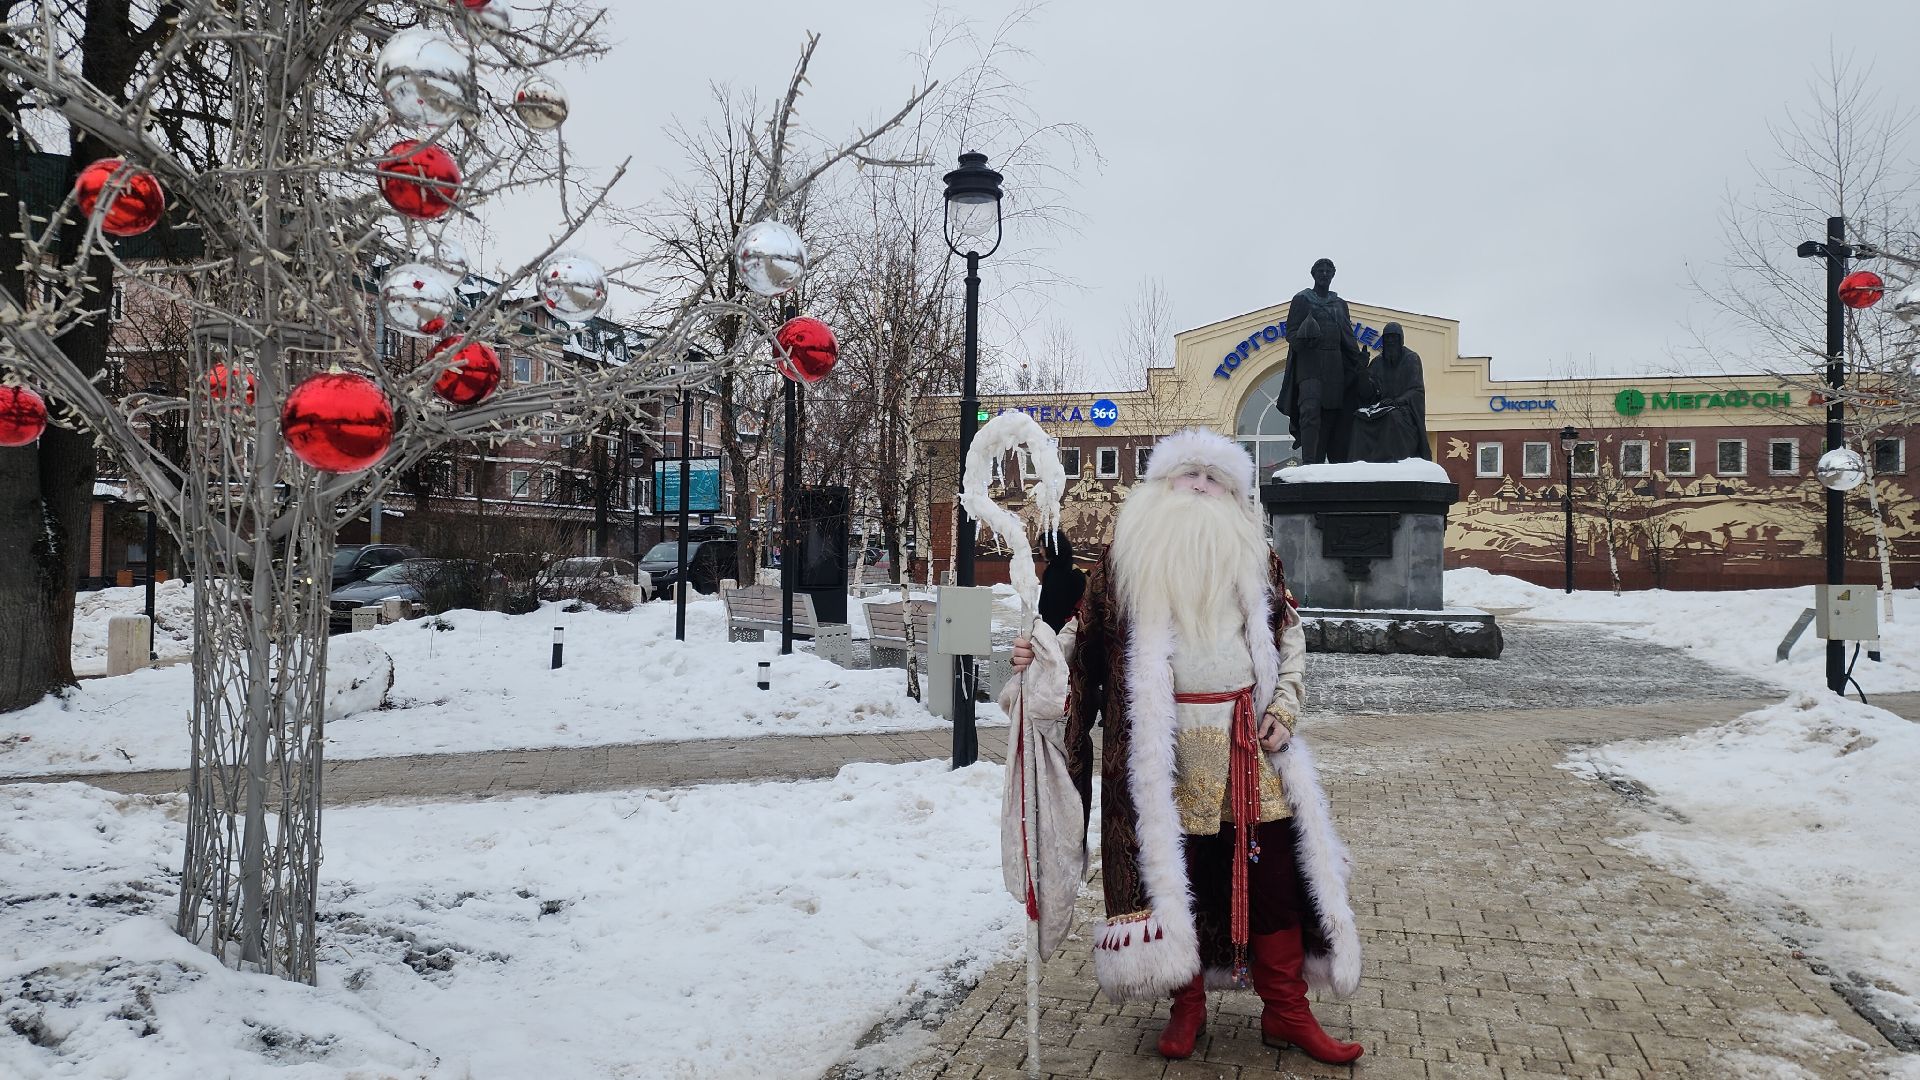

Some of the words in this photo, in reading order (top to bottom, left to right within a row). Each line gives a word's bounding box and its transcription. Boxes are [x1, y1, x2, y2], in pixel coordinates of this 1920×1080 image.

[1213, 321, 1287, 380] ТОРГОВ
[1490, 396, 1558, 412] Очкарик
[997, 405, 1083, 422] ТЕКА
